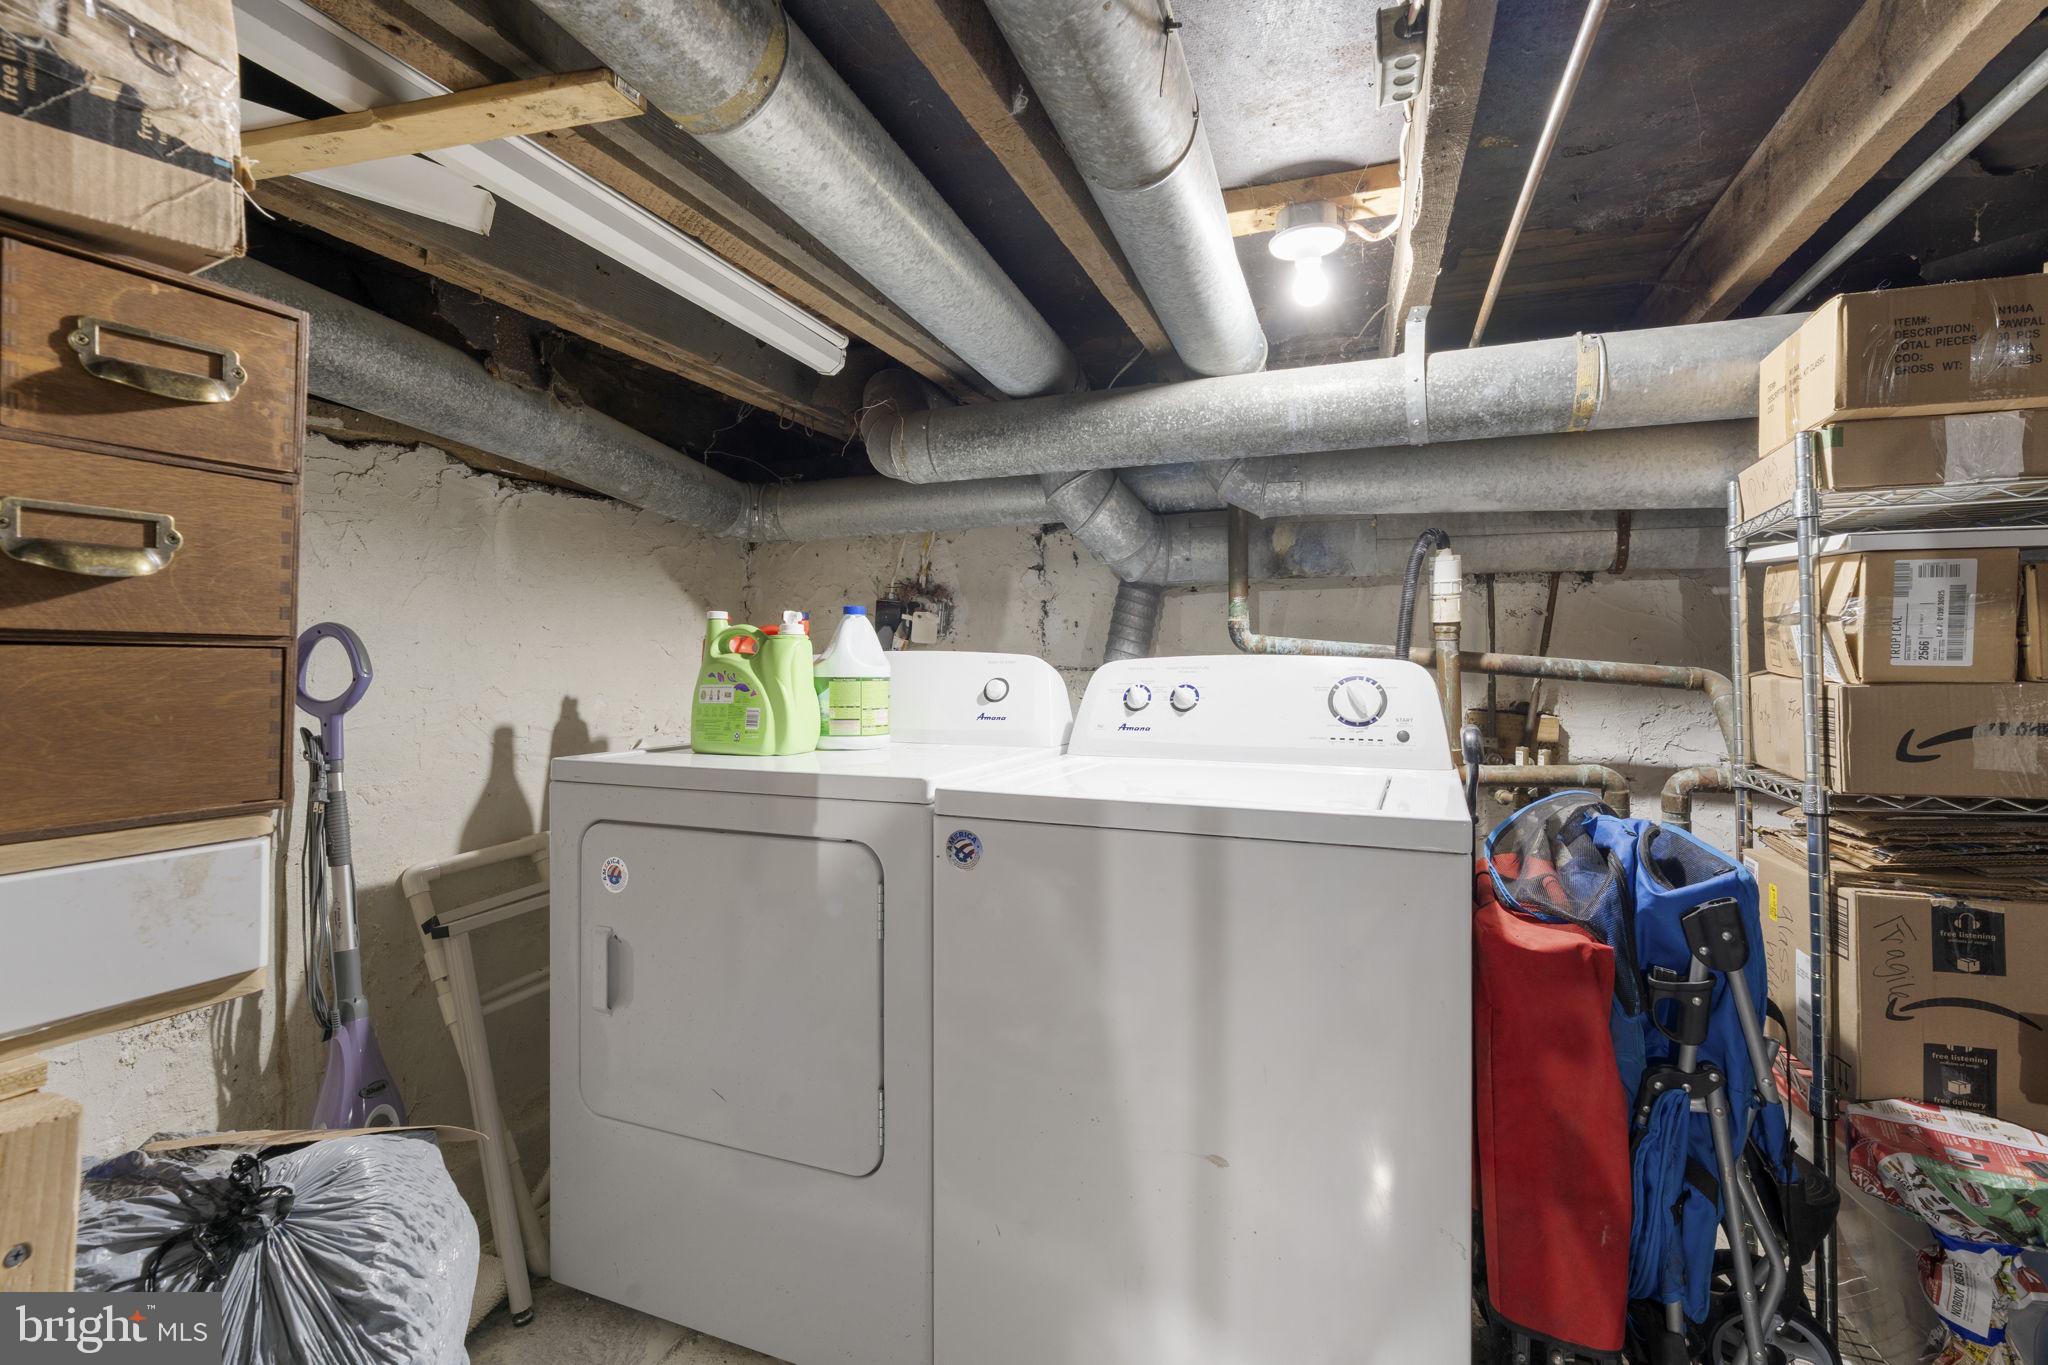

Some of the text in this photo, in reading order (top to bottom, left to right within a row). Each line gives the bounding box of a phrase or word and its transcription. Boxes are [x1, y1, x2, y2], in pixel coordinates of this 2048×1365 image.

[1894, 323, 1975, 339] DESCRIPTION:
[1894, 363, 1934, 376] GROSS
[1918, 640, 1930, 661] 2566
[976, 712, 1007, 721] Amana
[1117, 722, 1151, 732] Amana
[1939, 929, 1996, 942] free listening
[1932, 1052, 1989, 1065] free listening
[1933, 1096, 1986, 1110] free delivery
[1950, 1262, 1966, 1318] NOBODY BEATS
